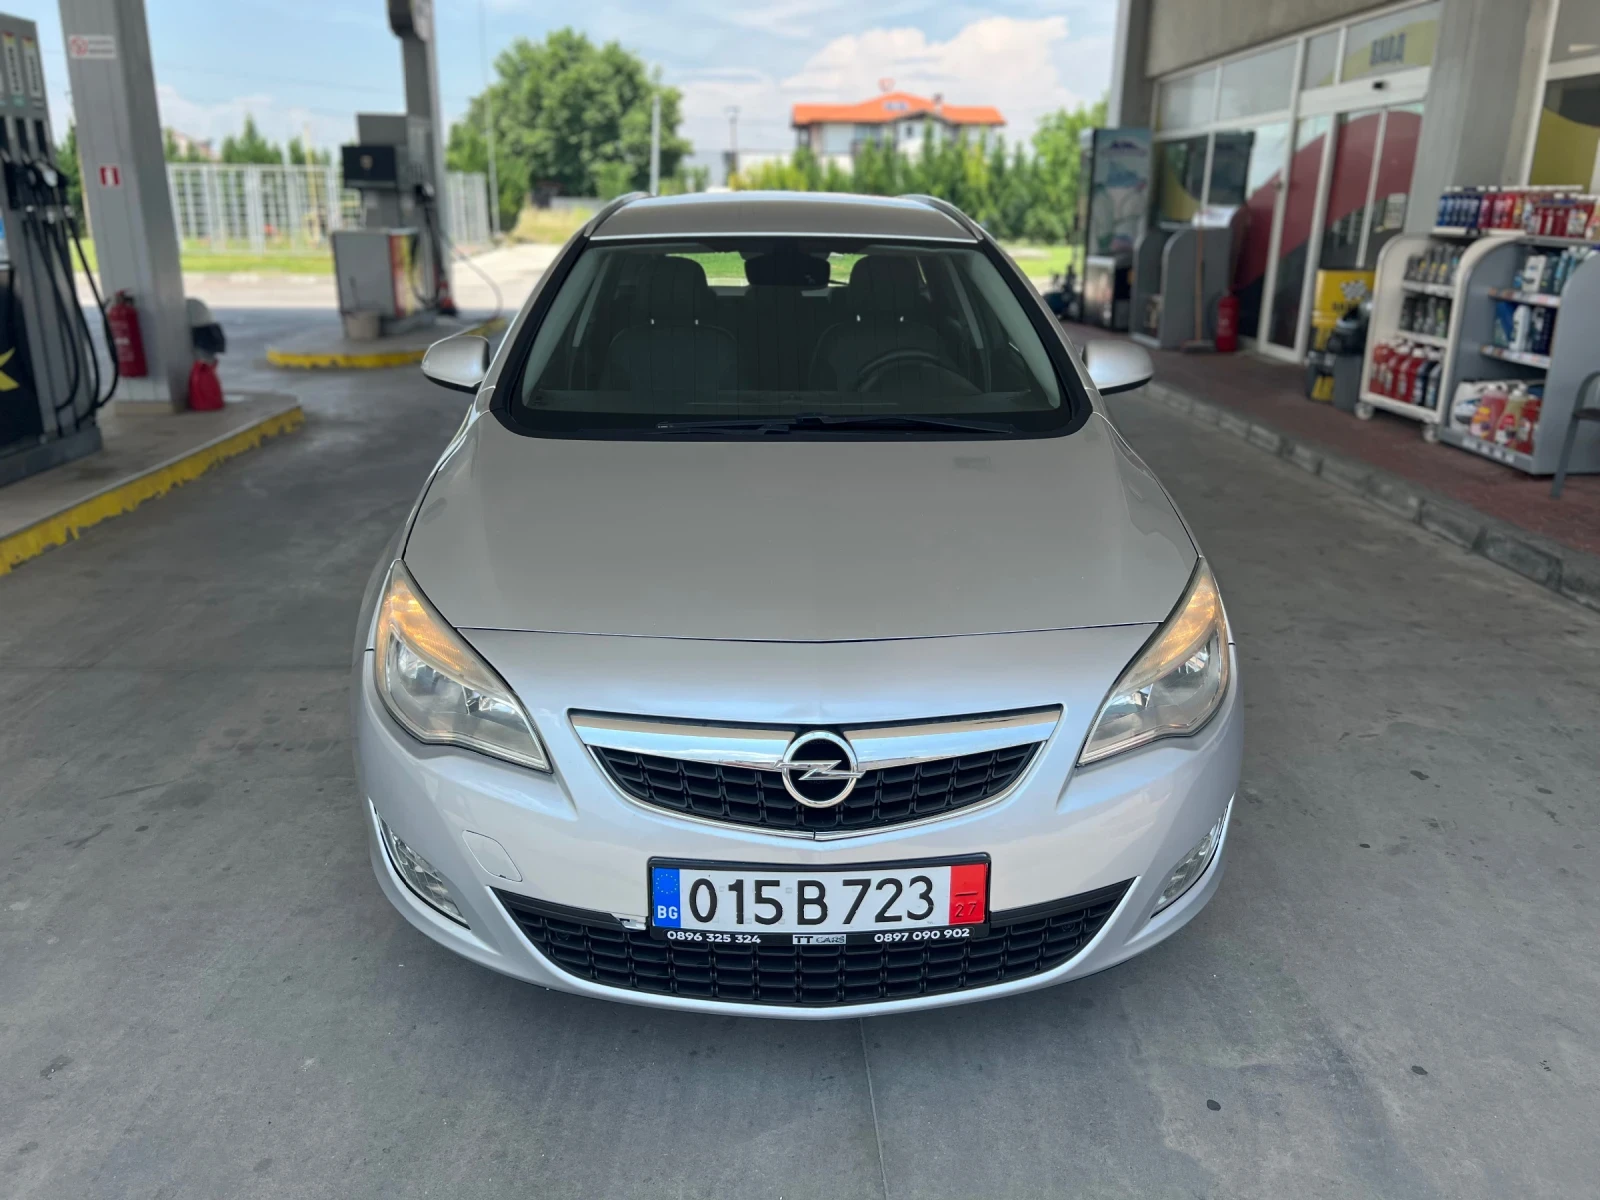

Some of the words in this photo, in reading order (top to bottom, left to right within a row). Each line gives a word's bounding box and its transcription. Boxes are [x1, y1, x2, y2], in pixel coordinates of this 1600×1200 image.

[657, 905, 678, 919] BG
[955, 903, 977, 917] 27
[667, 930, 702, 941] 0896
[706, 933, 731, 943] 325
[735, 934, 761, 944] 324
[794, 936, 813, 944] TT
[816, 936, 845, 944] CARS
[874, 932, 909, 943] 0897
[912, 930, 940, 940] 090
[943, 928, 970, 938] 902
